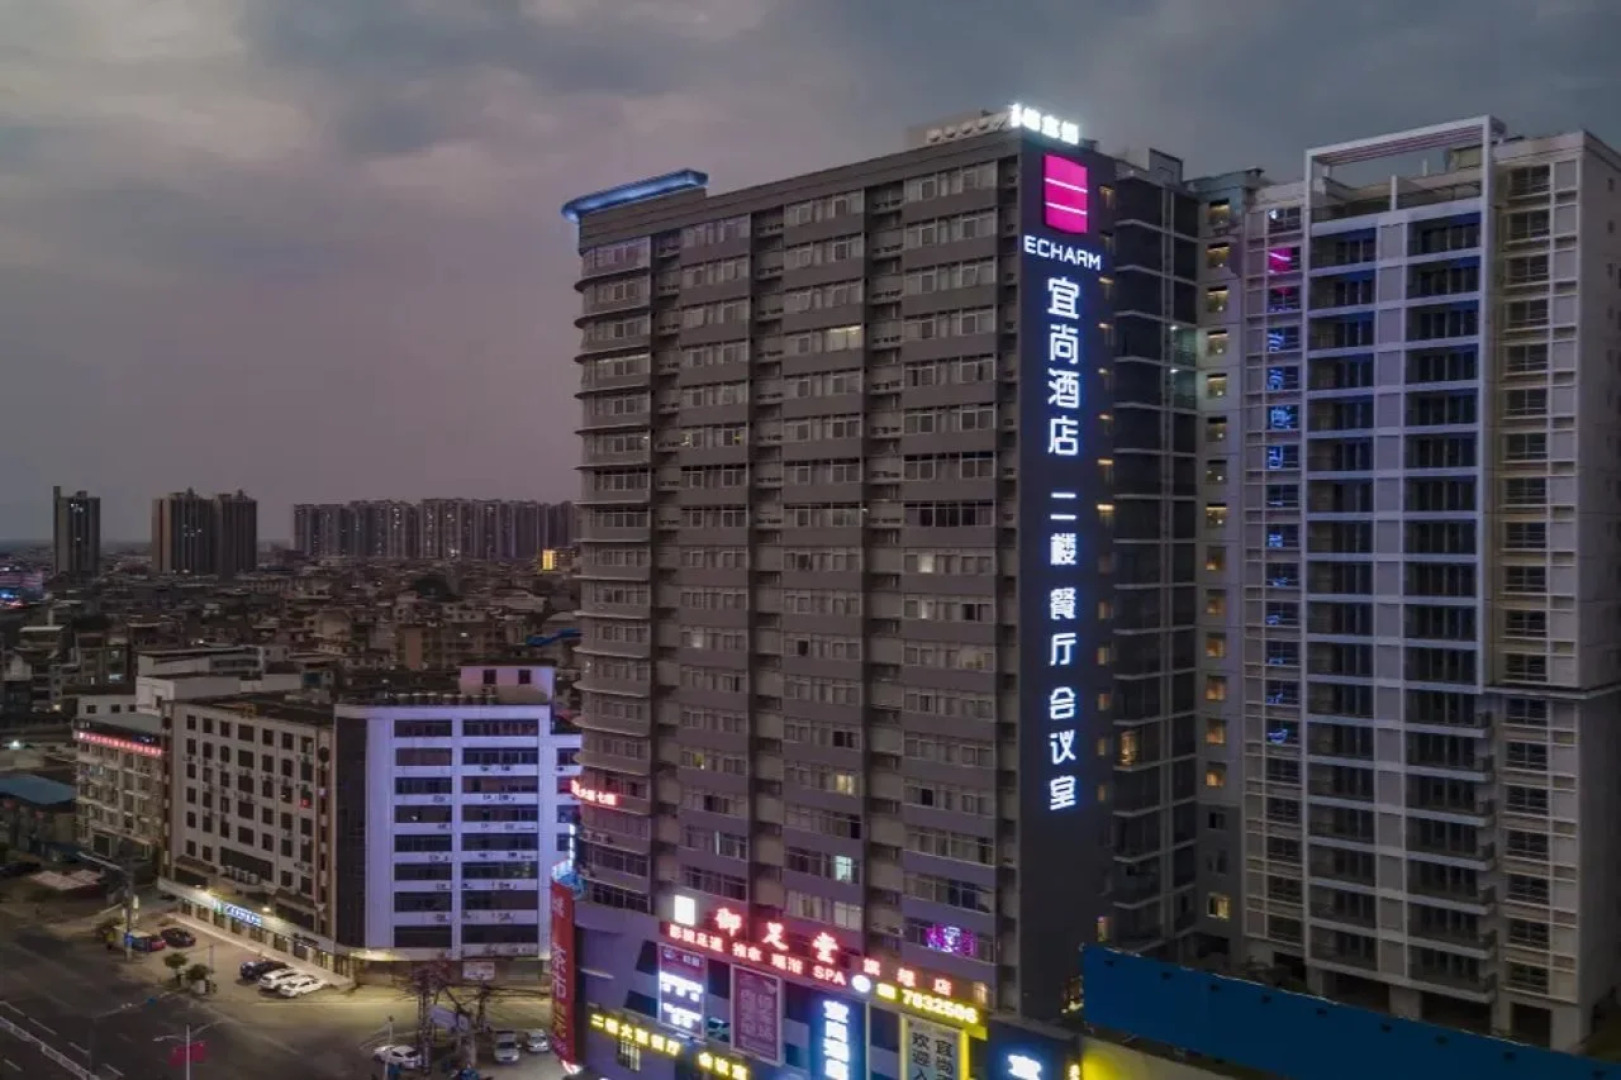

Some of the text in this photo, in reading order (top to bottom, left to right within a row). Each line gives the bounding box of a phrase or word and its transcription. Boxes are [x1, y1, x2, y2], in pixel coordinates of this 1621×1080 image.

[1023, 234, 1101, 271] ECHARM
[1047, 276, 1080, 457] 宜尚酒店
[1049, 491, 1078, 811] 二楼 餐厅 会议室
[813, 965, 847, 986] SPA
